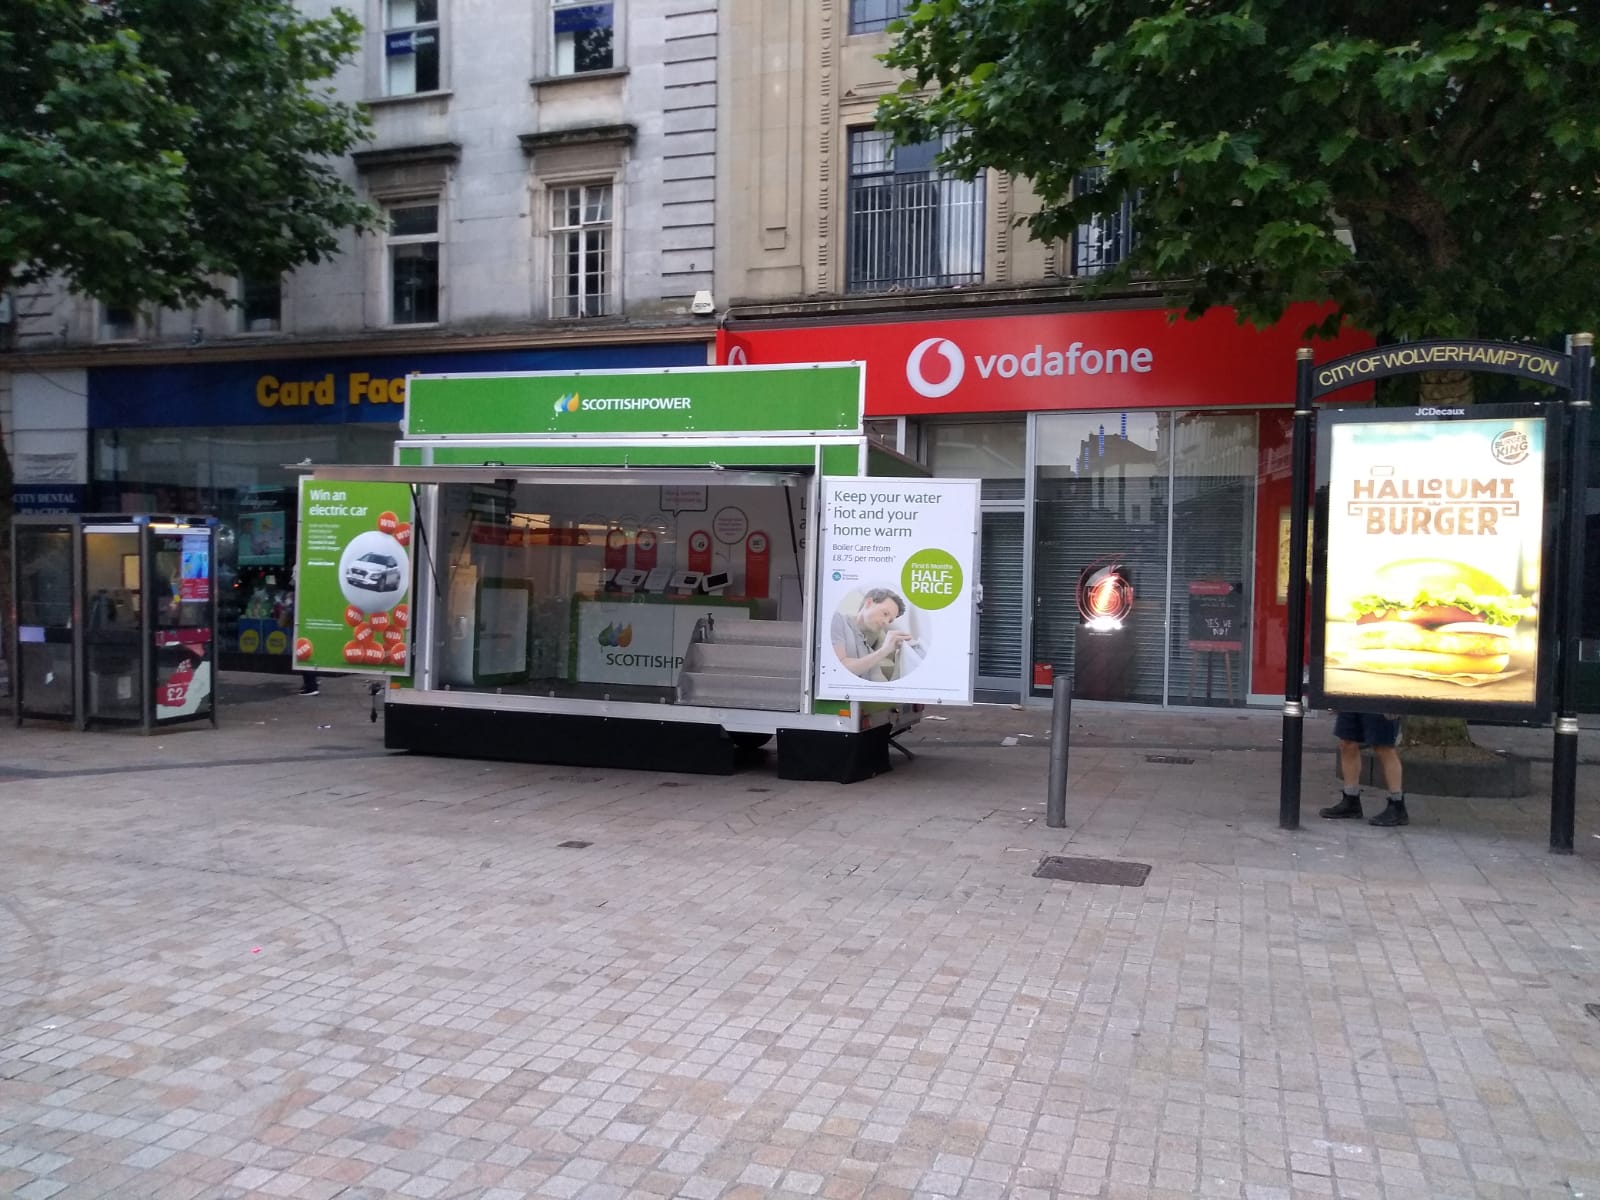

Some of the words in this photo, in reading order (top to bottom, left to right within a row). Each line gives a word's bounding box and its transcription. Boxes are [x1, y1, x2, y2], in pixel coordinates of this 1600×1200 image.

[974, 342, 1153, 379] vodafone
[1318, 363, 1354, 386] CITY
[1356, 356, 1382, 373] OF
[1382, 346, 1560, 376] WOLVERHAMPTON
[256, 373, 335, 407] Card
[582, 397, 691, 410] SCOTTISHPOWER
[1415, 408, 1465, 417] JCDecaux
[1496, 441, 1528, 458] KING
[310, 489, 330, 501] Win
[332, 491, 347, 501] an
[1353, 478, 1514, 499] HALLOUMI
[834, 490, 867, 504] Keep
[870, 492, 900, 505] your
[904, 493, 942, 504] water
[309, 504, 349, 516] electric
[350, 506, 368, 516] car
[834, 507, 859, 519] hot
[859, 508, 884, 520] and
[887, 510, 919, 523] your
[1366, 506, 1498, 535] BURGER
[833, 524, 872, 536] home
[874, 527, 912, 537] warm
[854, 544, 871, 552] Care
[872, 544, 891, 552] from
[911, 570, 953, 582] HALF-
[911, 582, 953, 594] PRICE
[606, 653, 684, 669] SCOTTISHP
[167, 687, 185, 701] £2
